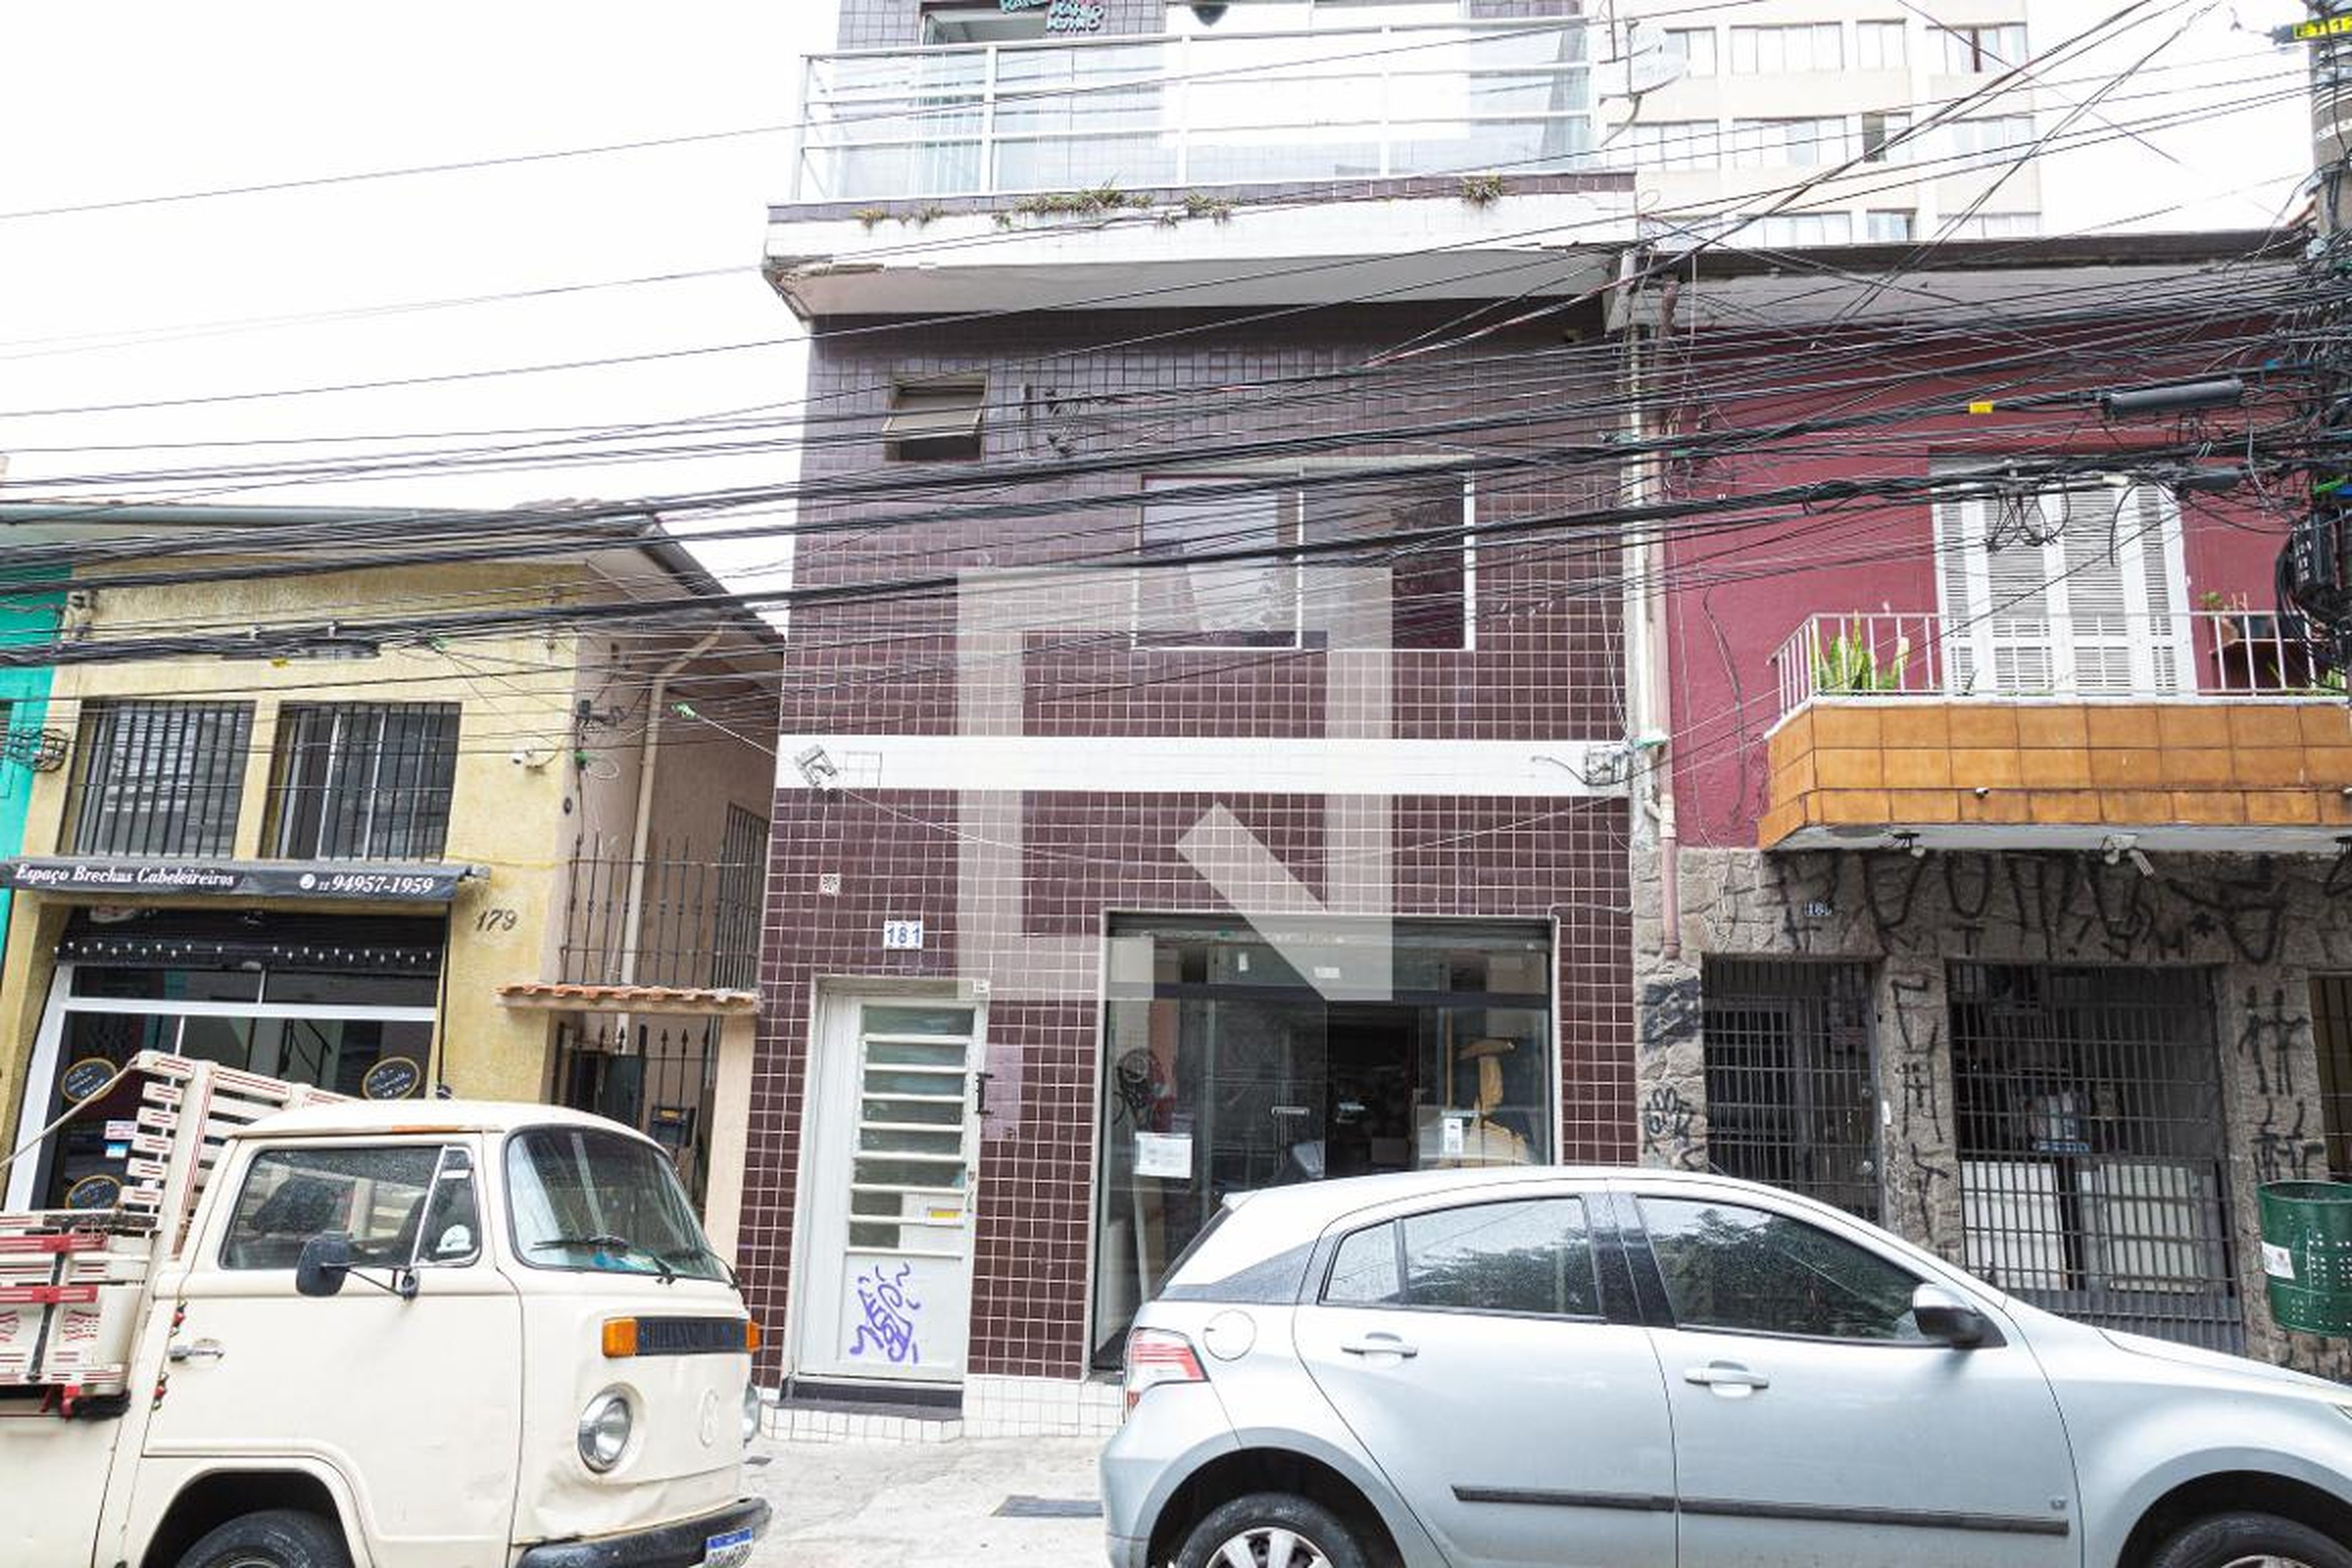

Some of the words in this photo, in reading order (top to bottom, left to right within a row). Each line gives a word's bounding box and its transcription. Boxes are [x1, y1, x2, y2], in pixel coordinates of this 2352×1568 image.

[15, 862, 68, 884] Espaço
[137, 867, 234, 887] Cabeleireiros
[332, 875, 434, 895] 94957-1959
[477, 909, 516, 932] 179
[887, 926, 920, 944] 181
